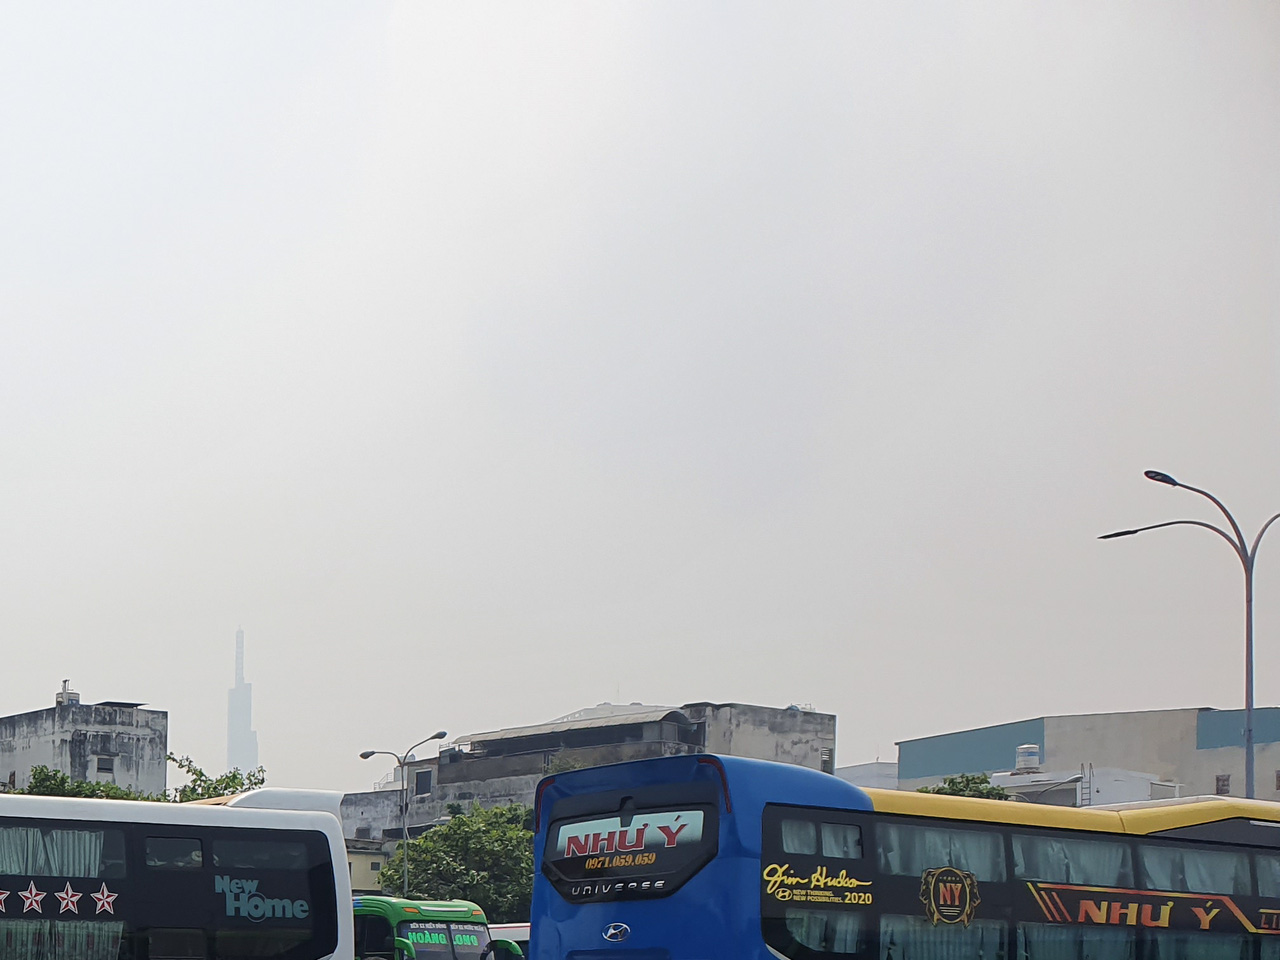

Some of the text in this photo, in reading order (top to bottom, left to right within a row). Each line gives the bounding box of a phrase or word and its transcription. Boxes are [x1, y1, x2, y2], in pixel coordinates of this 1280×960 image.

[564, 815, 688, 857] NHƯ Ý
[214, 875, 259, 894] New
[939, 883, 962, 906] NY
[226, 892, 309, 922] Home
[844, 892, 873, 904] 2020
[1077, 900, 1221, 930] NHƯ Ý
[408, 930, 447, 944] HOÀNG
